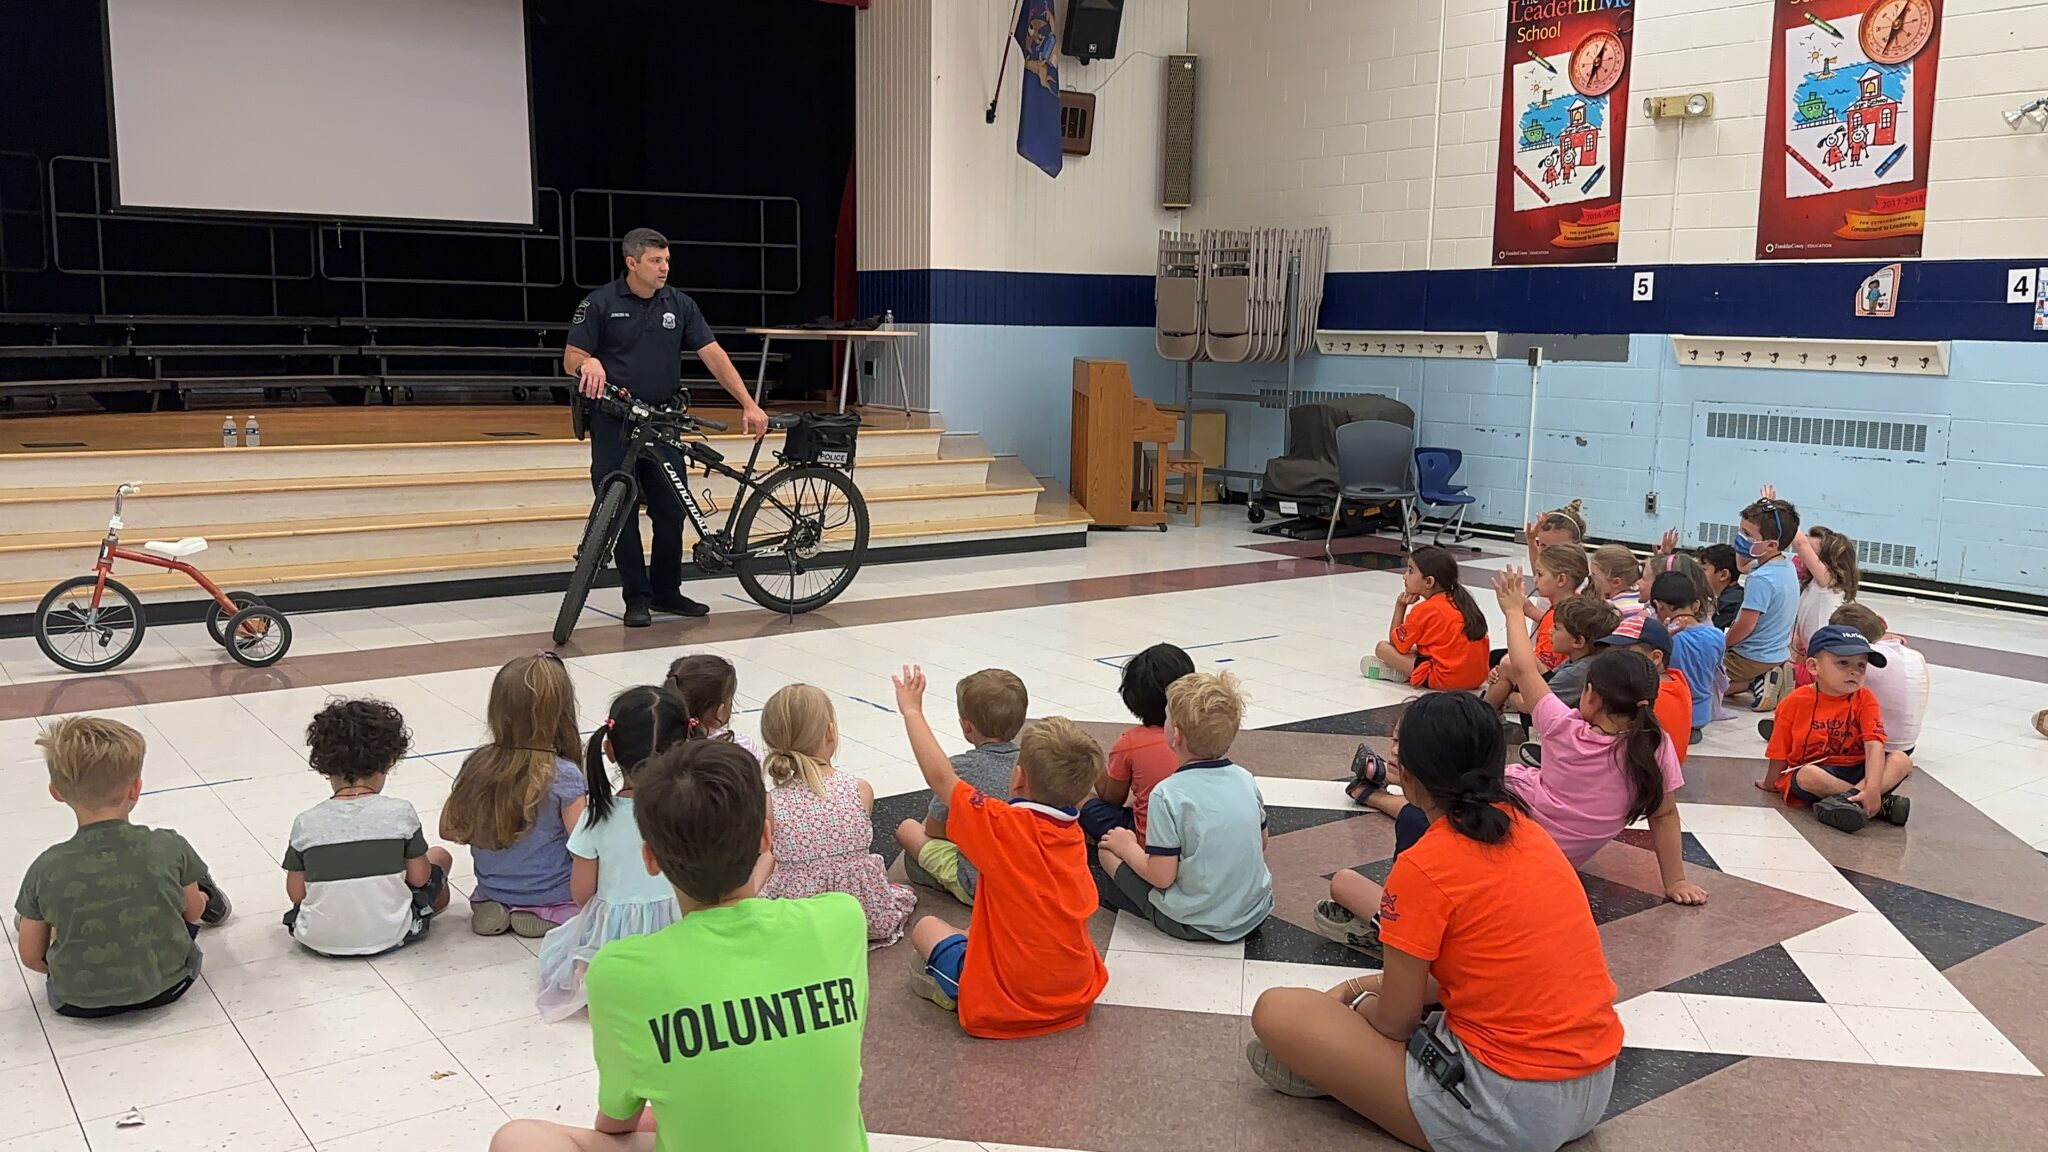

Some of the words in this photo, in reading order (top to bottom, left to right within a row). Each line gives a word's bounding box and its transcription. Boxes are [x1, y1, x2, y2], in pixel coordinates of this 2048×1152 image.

[1510, 0, 1576, 23] Leader
[1517, 21, 1561, 43] School
[1637, 278, 1649, 296] 5
[2013, 276, 2029, 296] 4
[820, 453, 846, 461] POLICE
[648, 977, 858, 1064] VOLUNTEER
